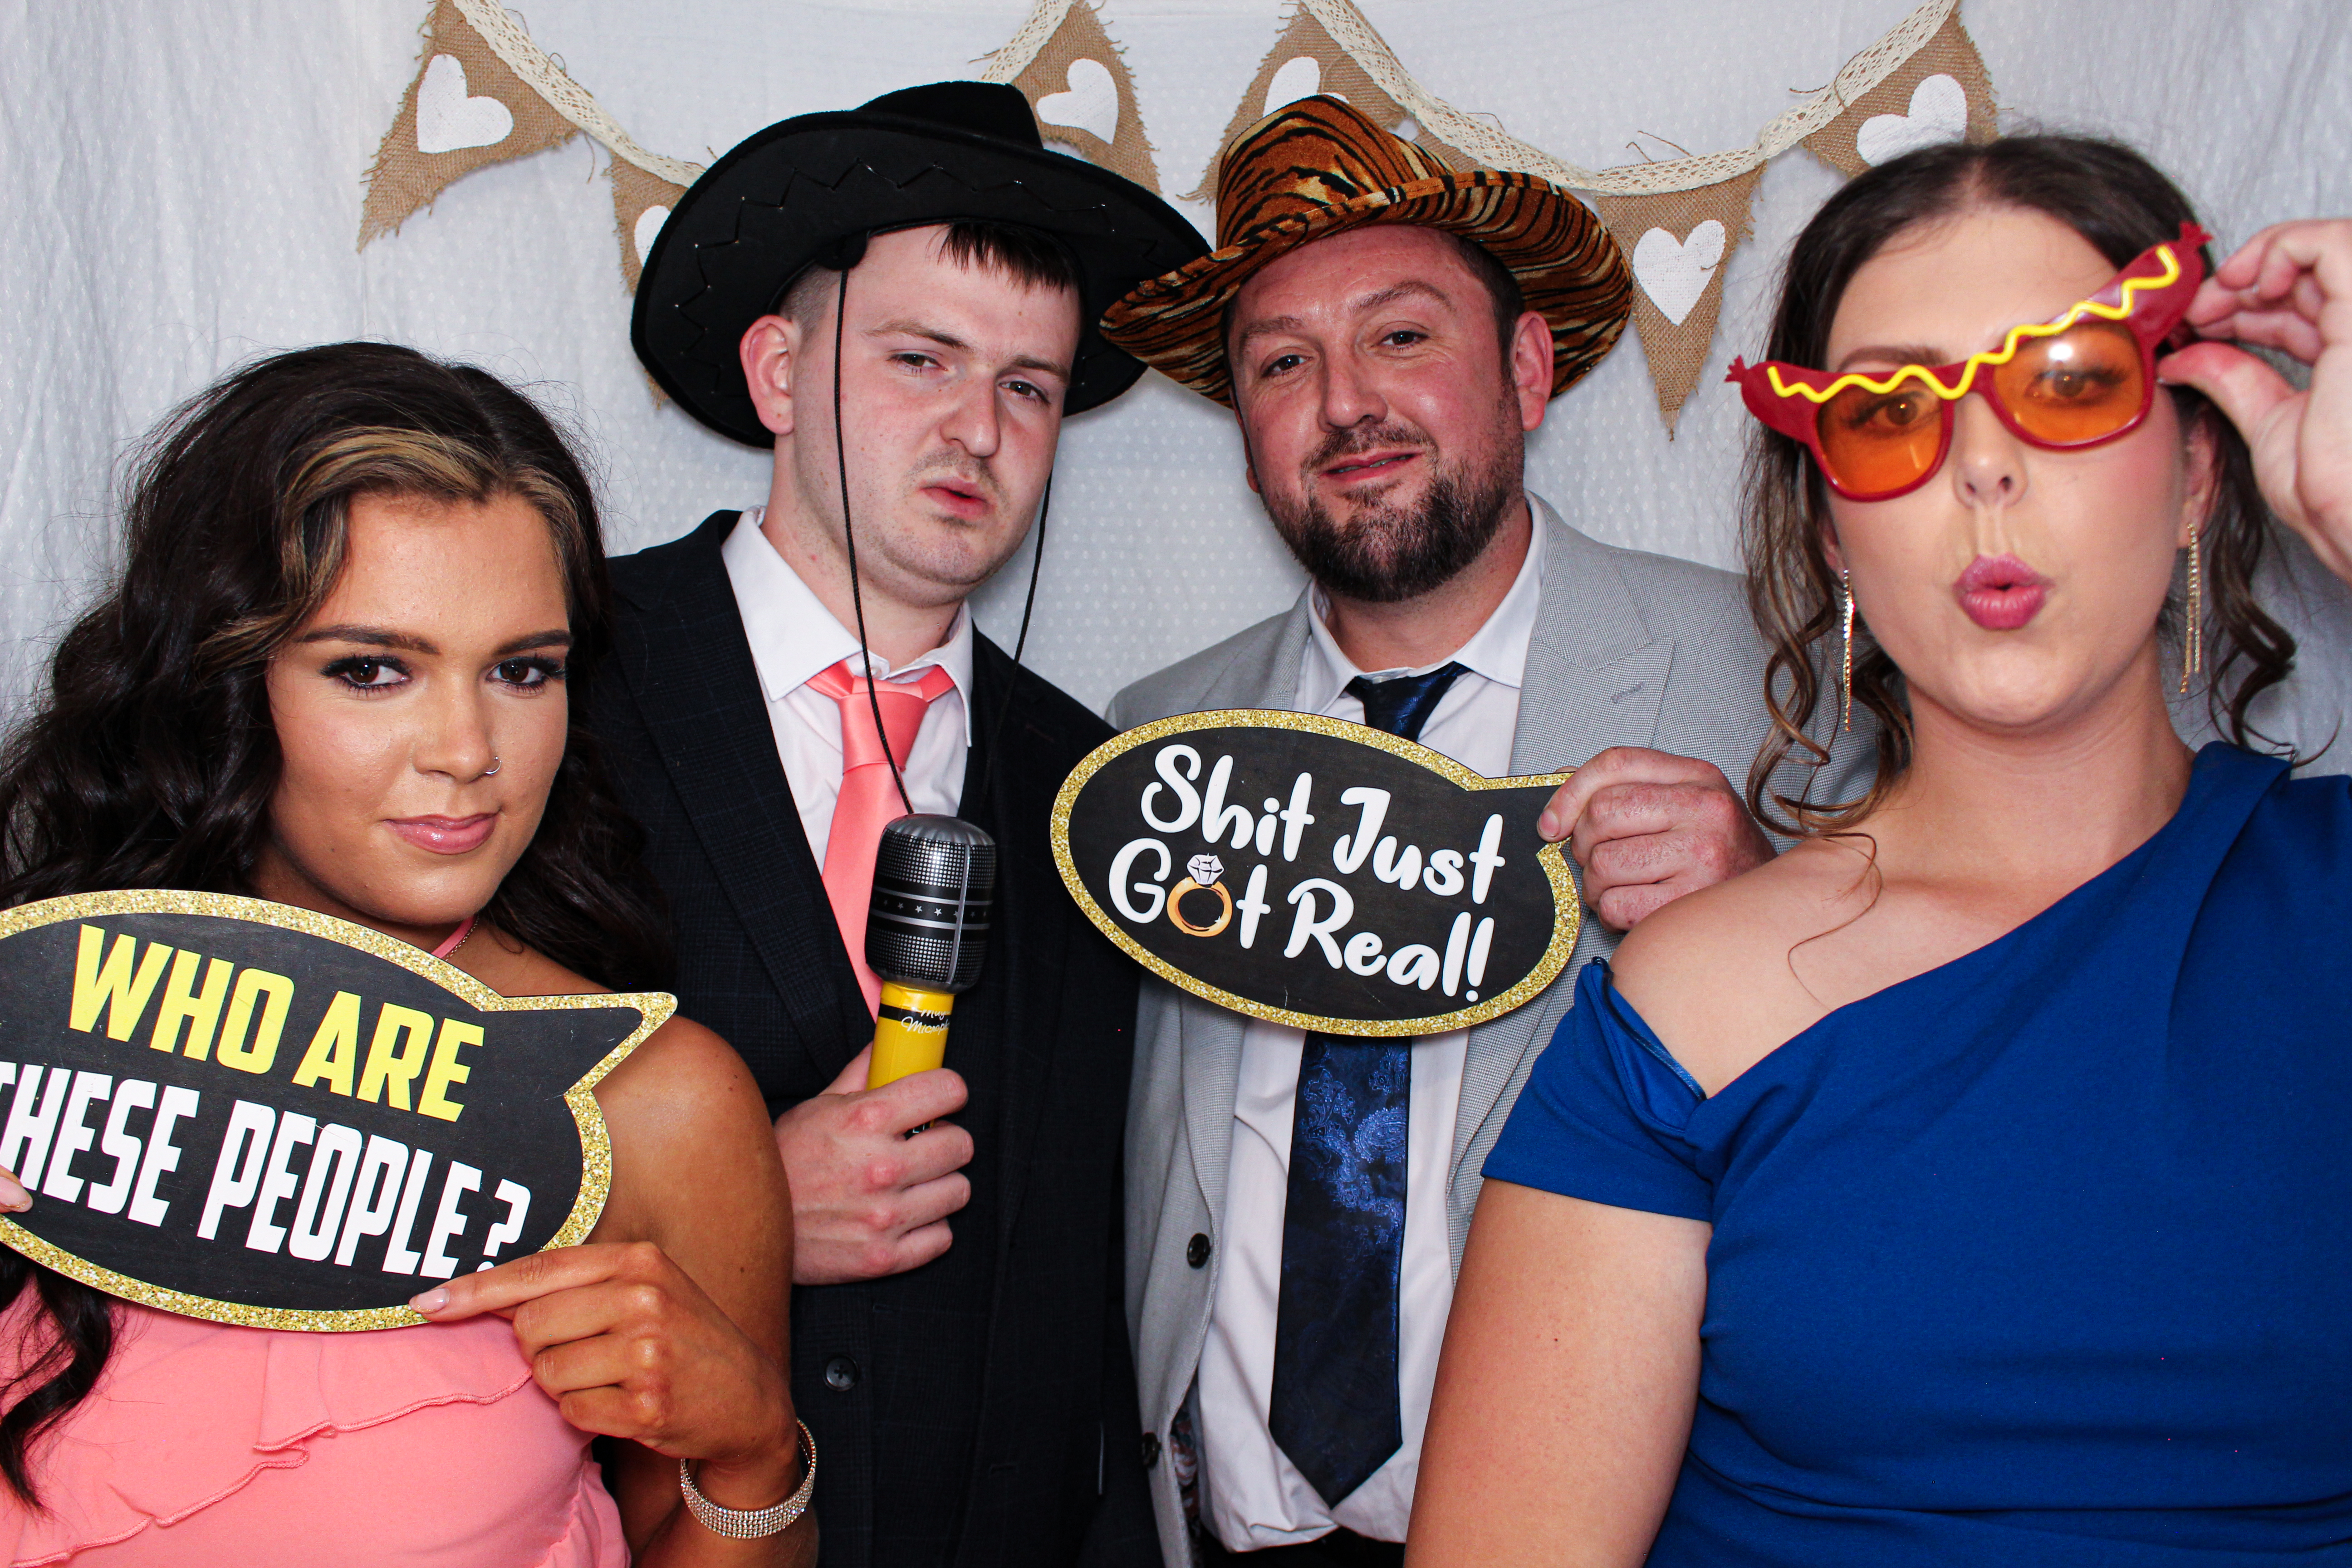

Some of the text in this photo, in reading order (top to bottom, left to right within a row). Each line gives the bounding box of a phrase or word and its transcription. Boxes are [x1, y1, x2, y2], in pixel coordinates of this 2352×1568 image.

[1141, 744, 1505, 904] Shit Just
[1284, 878, 1494, 1002] Real!
[69, 924, 484, 1122] WHO ARE
